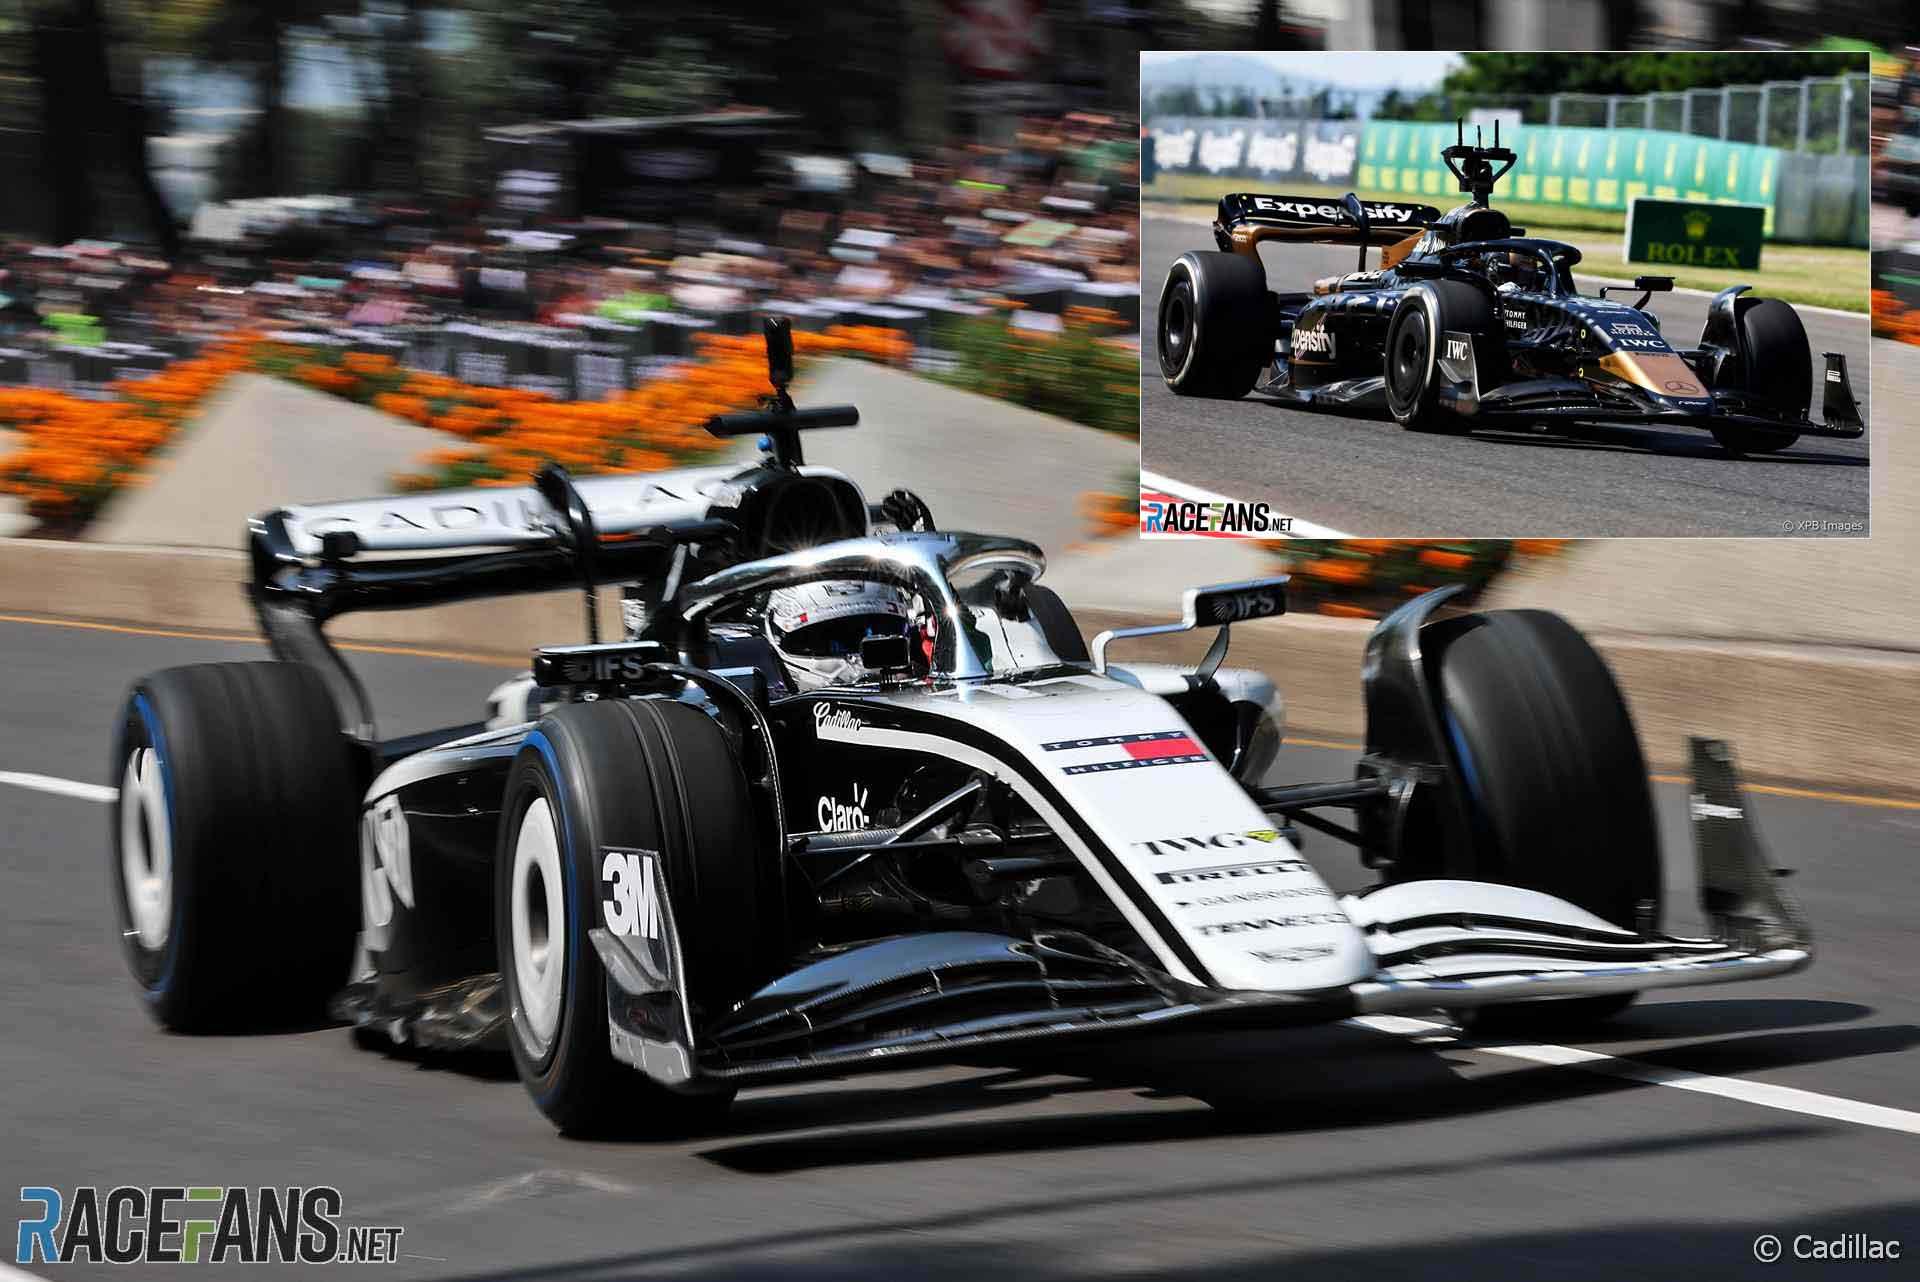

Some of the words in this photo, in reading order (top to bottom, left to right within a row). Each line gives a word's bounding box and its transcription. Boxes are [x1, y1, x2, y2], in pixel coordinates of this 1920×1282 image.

[1647, 241, 1739, 266] ROLEX
[1504, 309, 1526, 319] TOMMY
[1446, 339, 1468, 360] IWC
[1619, 339, 1666, 348] IWC
[595, 655, 643, 680] IFS
[813, 701, 862, 732] Cadillac
[1050, 732, 1183, 750] TOMMY
[1067, 755, 1207, 774] HILFIGER
[818, 794, 866, 832] Claro
[1130, 832, 1245, 855] TWG
[1154, 860, 1311, 884] PIRELLI
[602, 852, 659, 939] 3M
